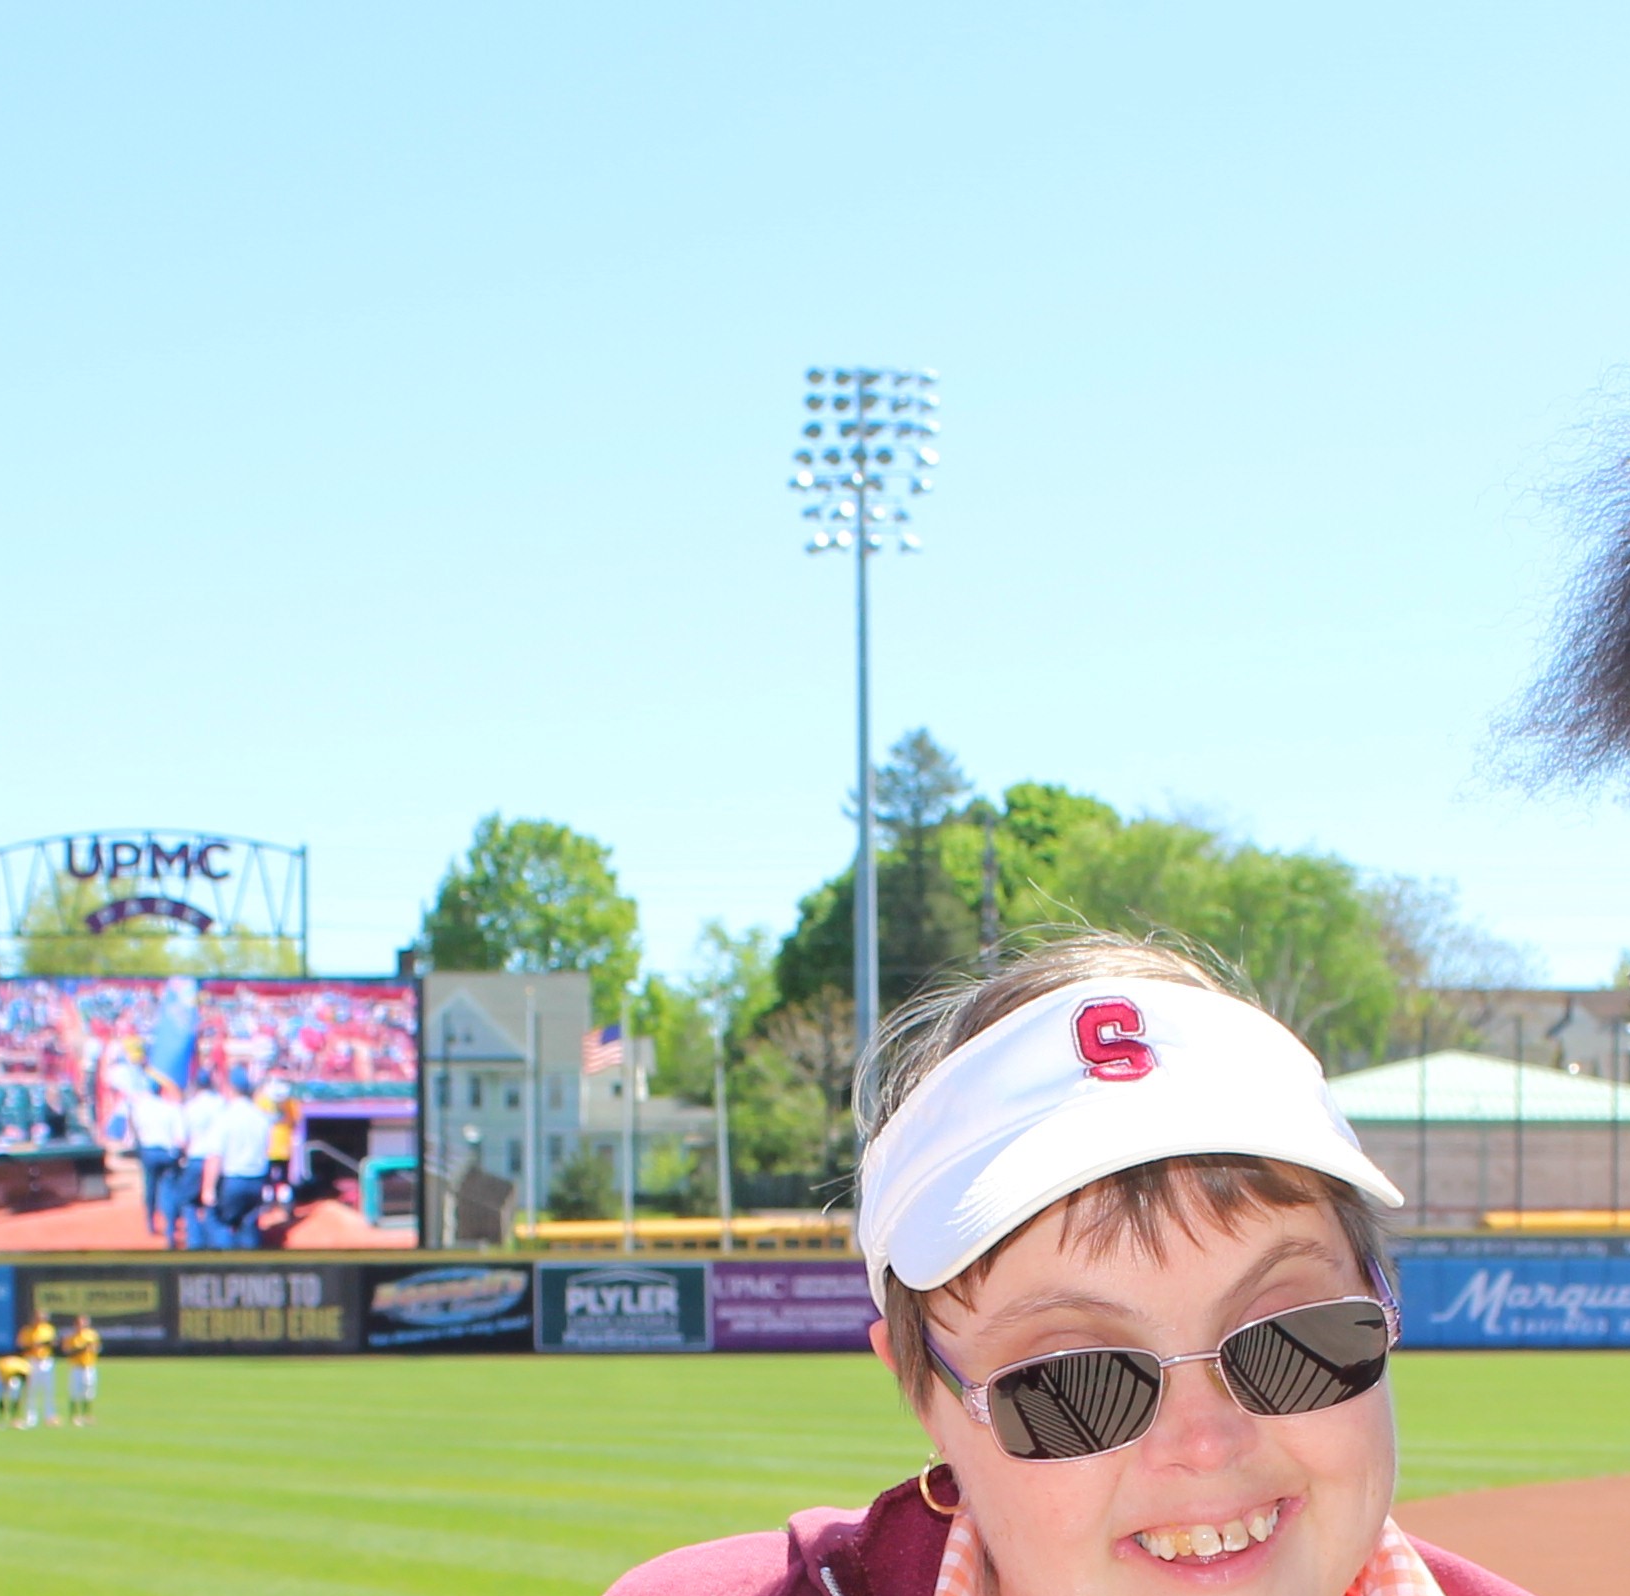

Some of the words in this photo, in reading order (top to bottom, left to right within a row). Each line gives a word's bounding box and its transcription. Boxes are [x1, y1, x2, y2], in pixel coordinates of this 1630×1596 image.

[66, 840, 231, 880] UPMC
[1072, 996, 1158, 1082] S
[178, 1273, 284, 1307] HELPING
[287, 1273, 321, 1307] TO
[566, 1285, 678, 1315] PLYLER
[178, 1308, 284, 1341] REBUILD
[287, 1306, 343, 1341] ERIE
[1509, 1318, 1611, 1334] SAVINGS
